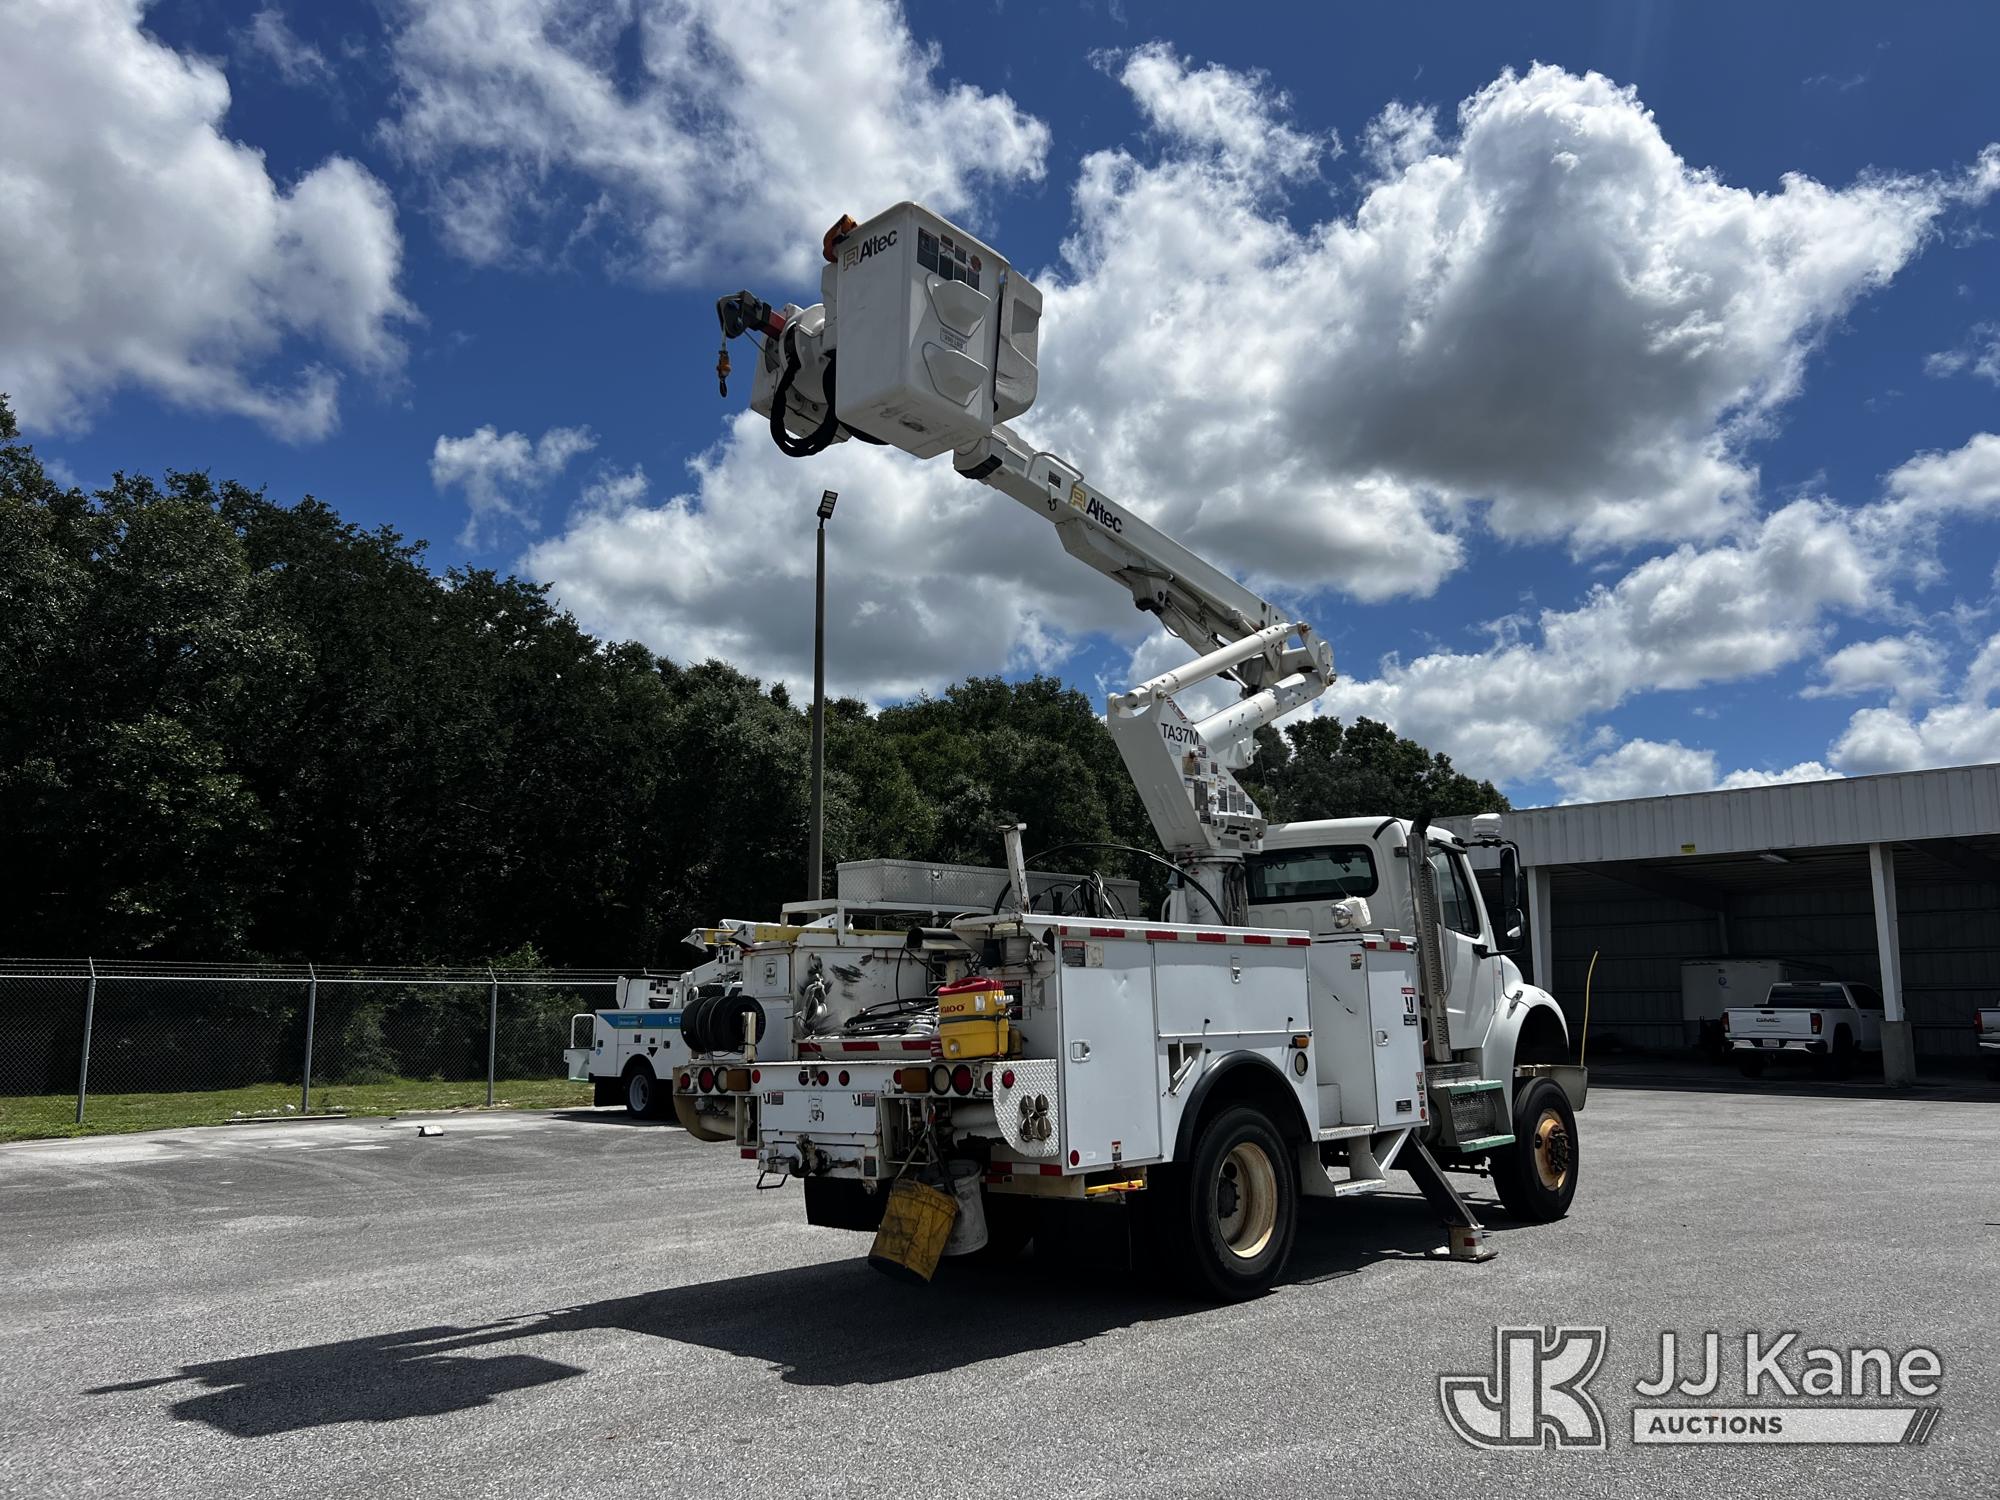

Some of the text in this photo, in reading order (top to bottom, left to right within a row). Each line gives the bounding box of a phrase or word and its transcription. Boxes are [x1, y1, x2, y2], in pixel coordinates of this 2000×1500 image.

[859, 230, 898, 263] Altec
[1086, 497, 1123, 534] Altec
[1160, 722, 1199, 745] TA37M
